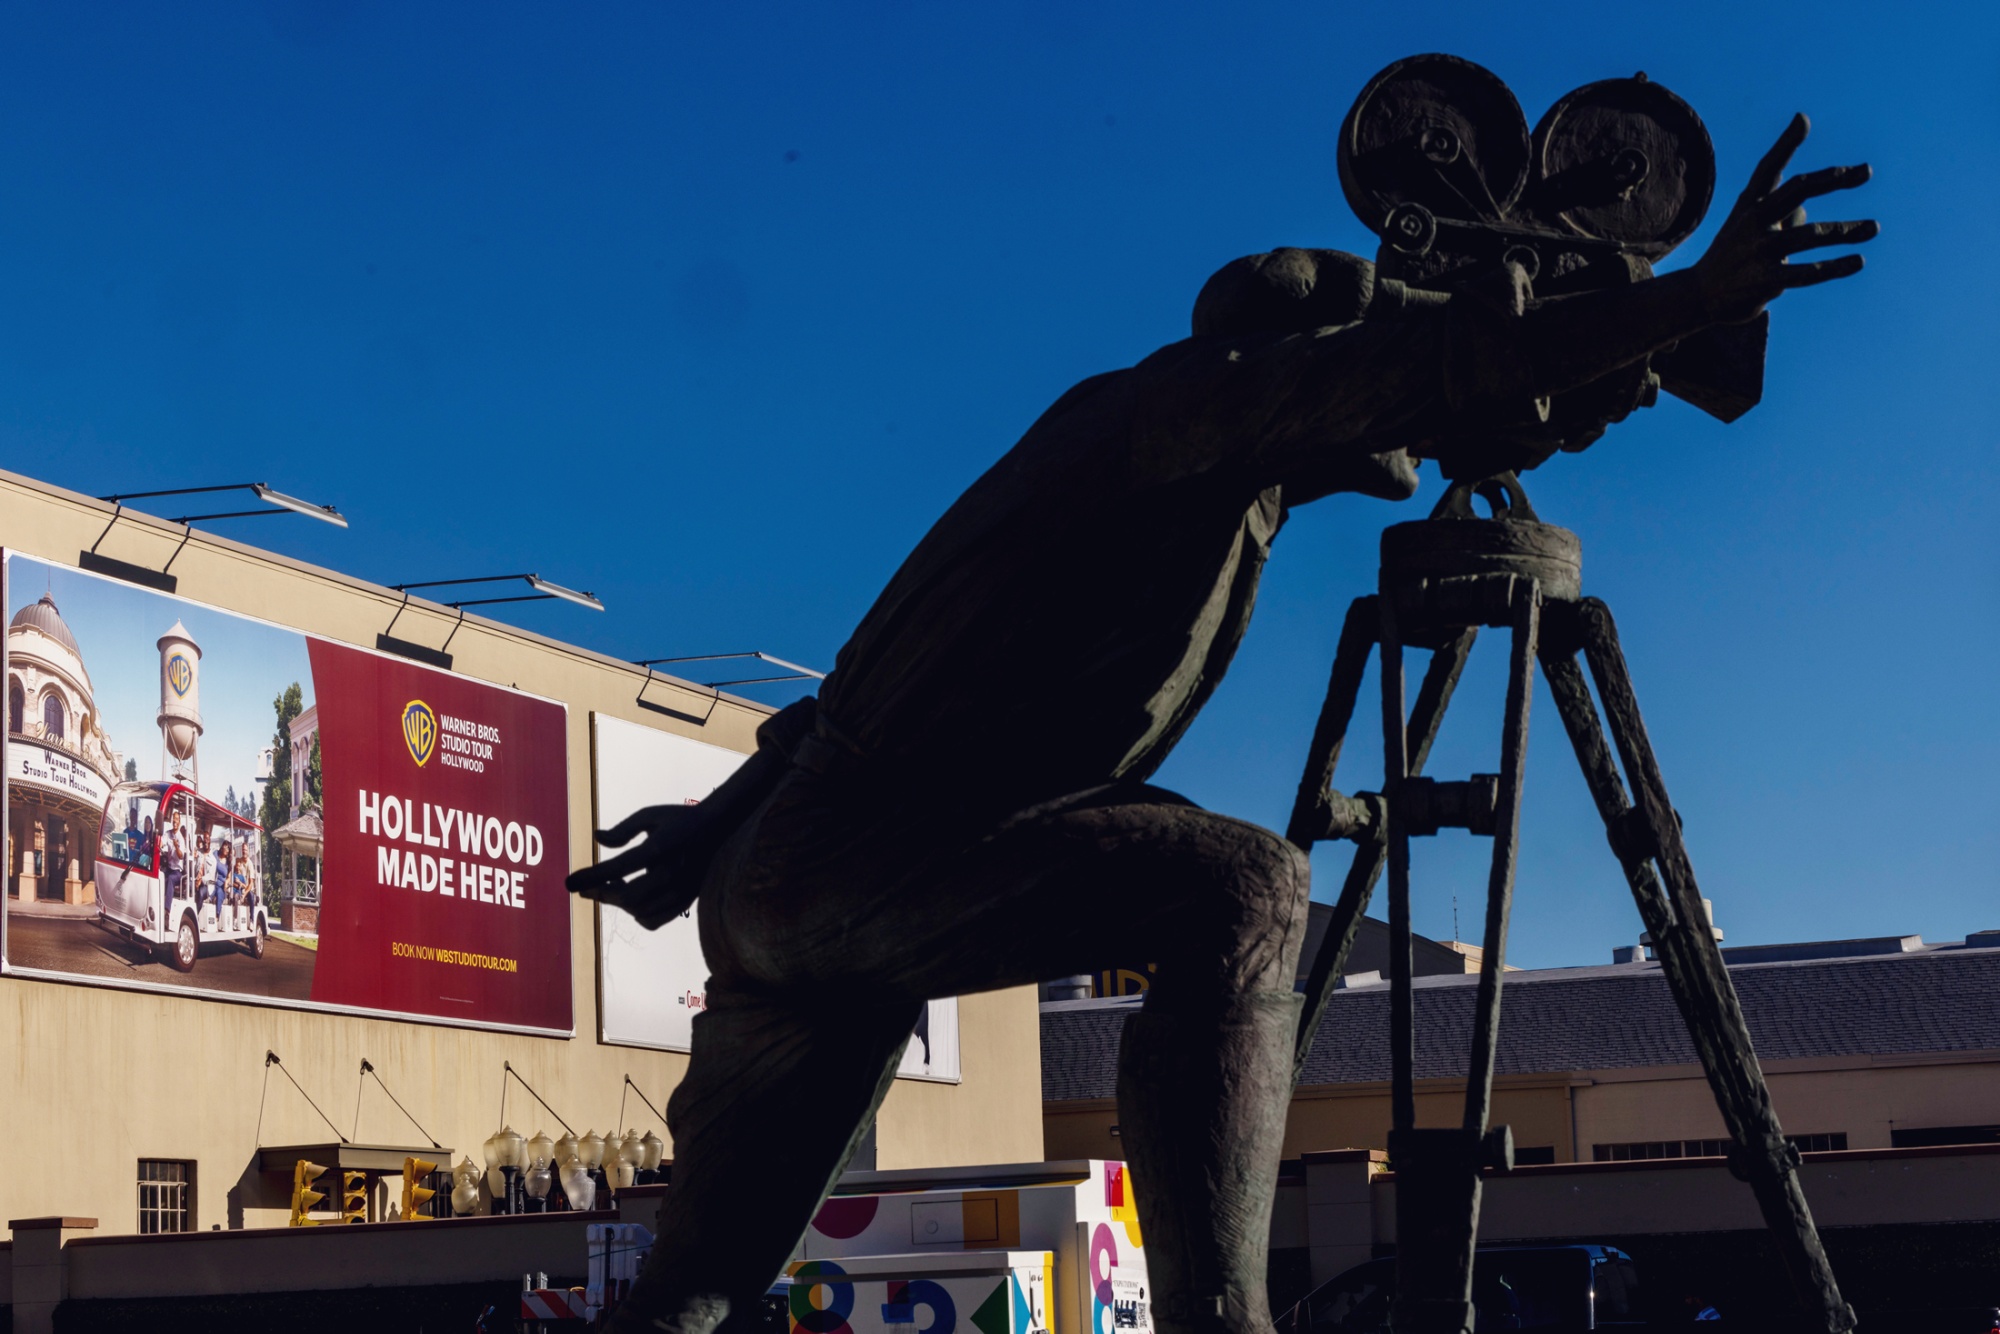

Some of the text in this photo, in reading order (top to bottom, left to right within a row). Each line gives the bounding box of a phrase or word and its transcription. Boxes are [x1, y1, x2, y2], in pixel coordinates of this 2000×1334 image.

[405, 707, 433, 759] WB
[440, 713, 501, 744] WARNER BROS.
[441, 733, 493, 761] STUDIO TOUR
[441, 752, 484, 773] HOLLYWOOD
[359, 788, 544, 867] HOLLYWOOD
[377, 845, 455, 897] MADE
[392, 941, 517, 973] BOOK NOW WBSTUDIOTOUR.COM
